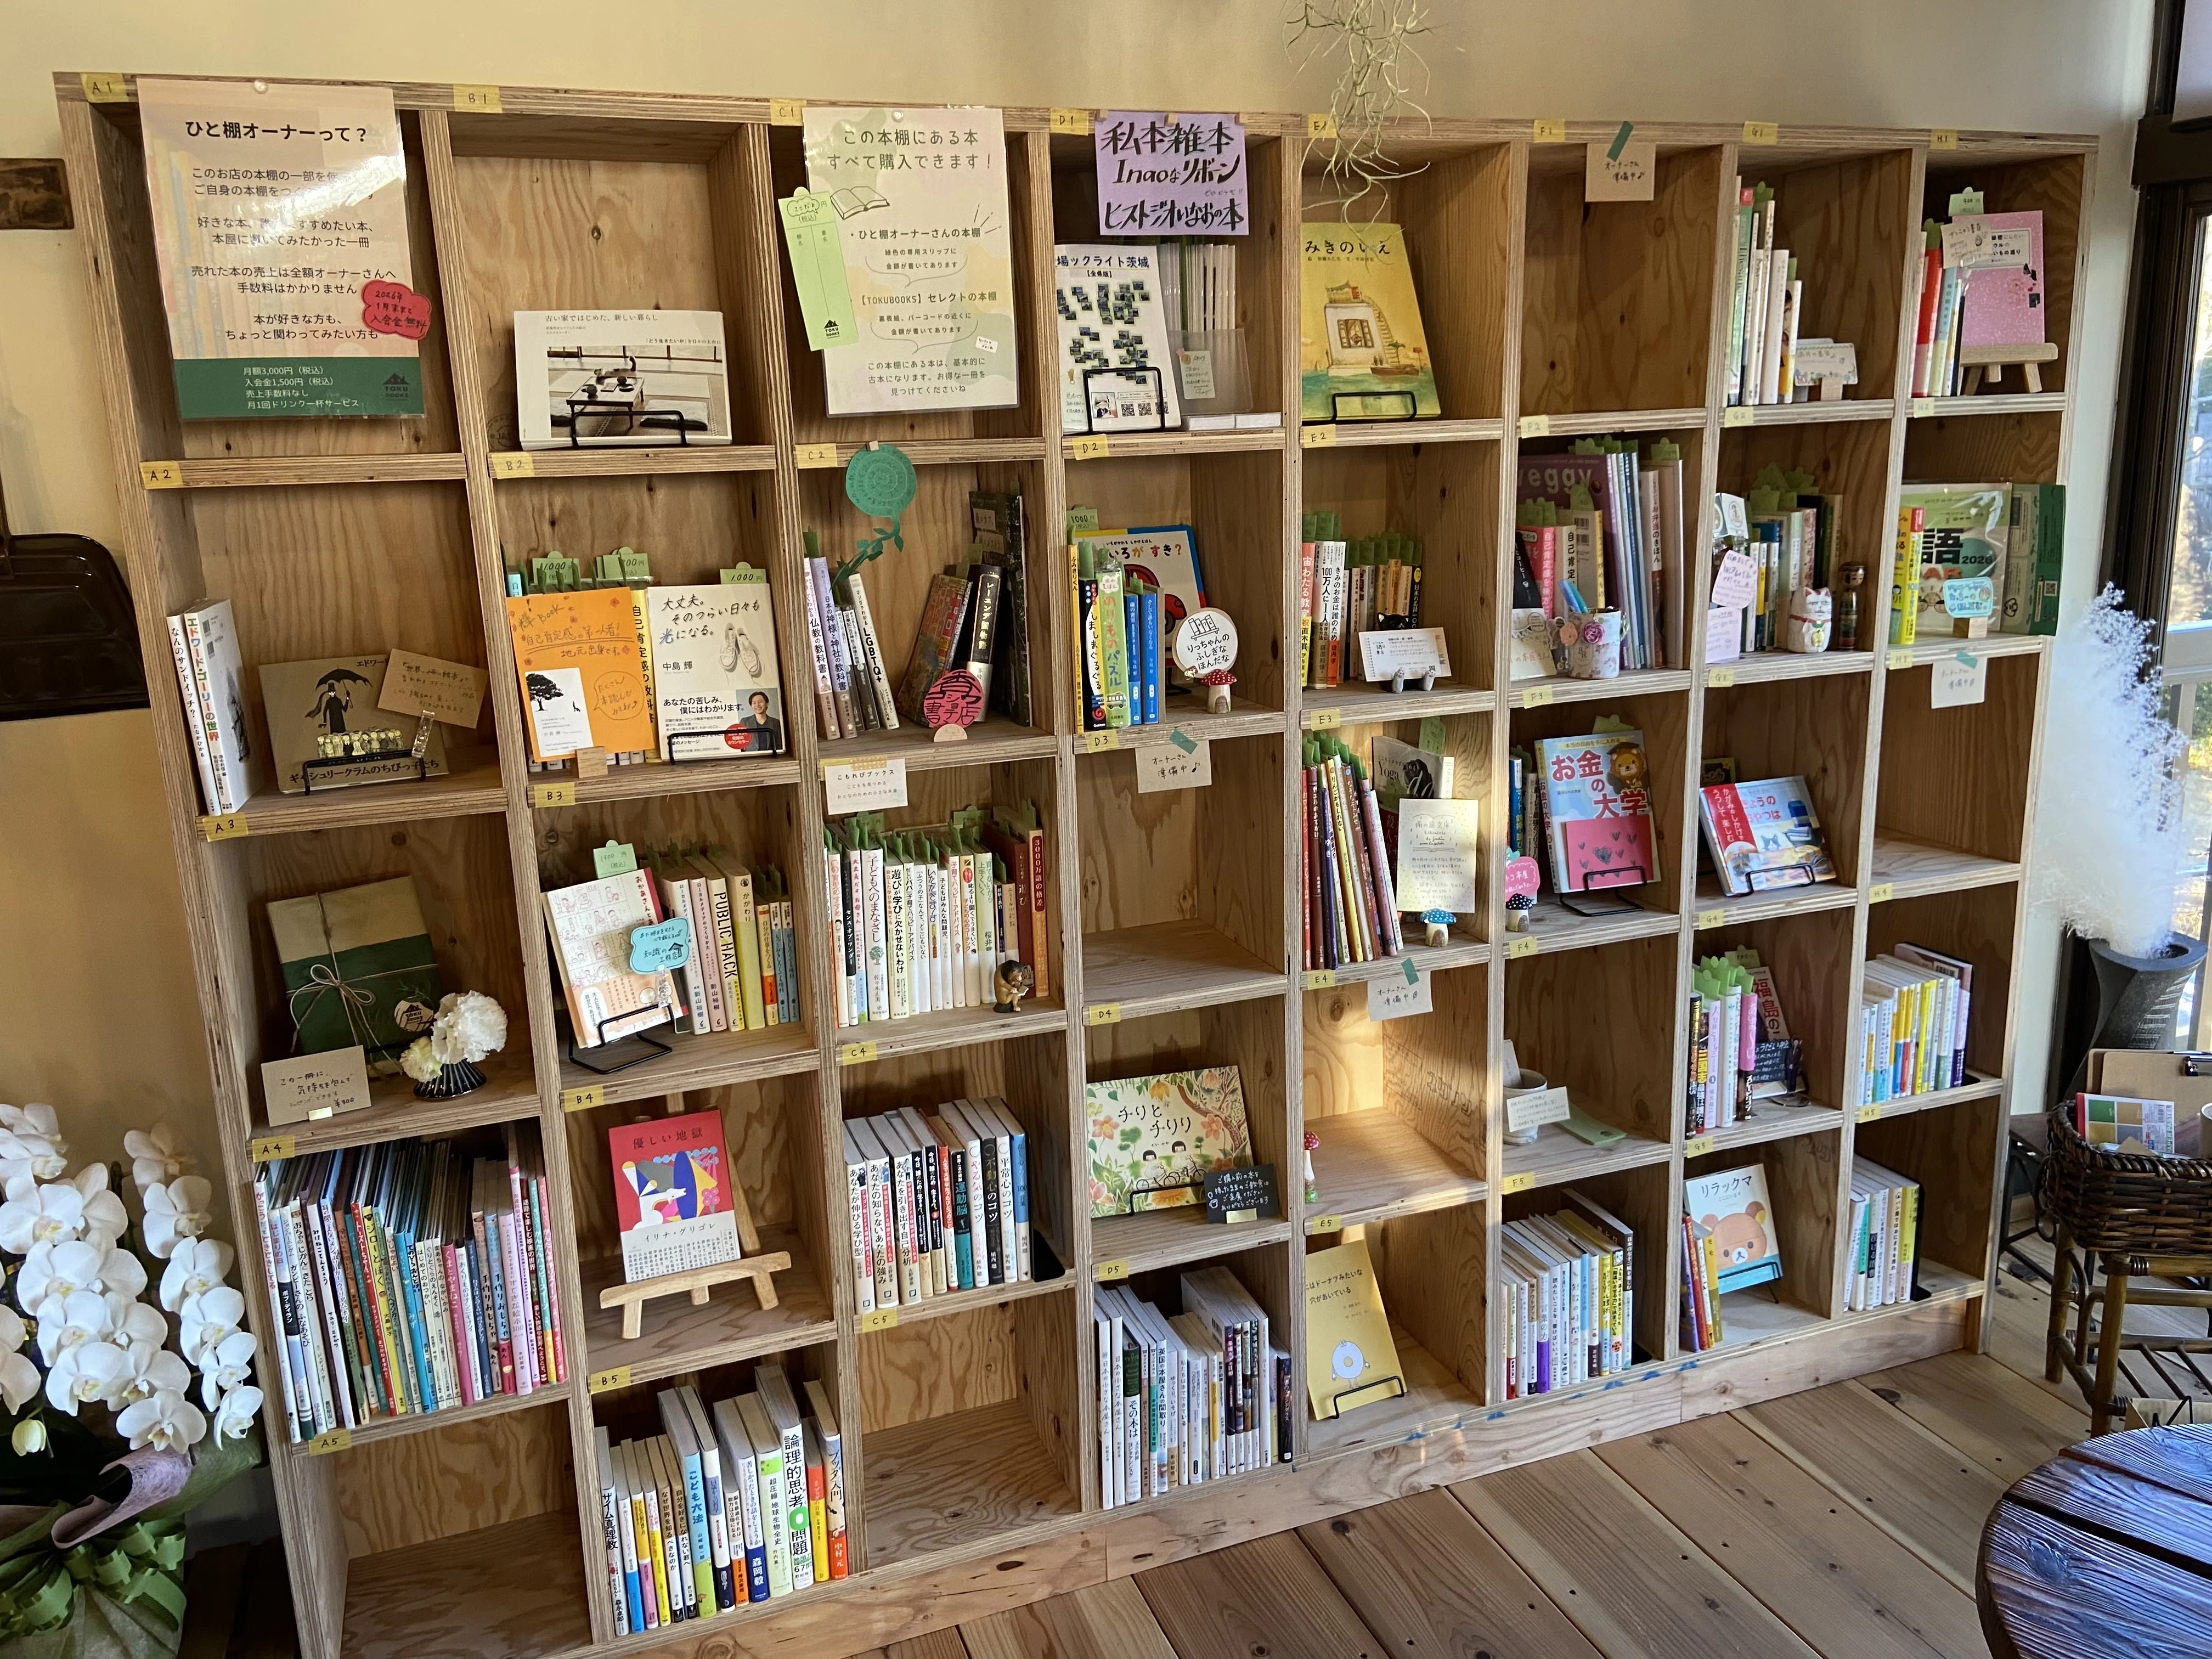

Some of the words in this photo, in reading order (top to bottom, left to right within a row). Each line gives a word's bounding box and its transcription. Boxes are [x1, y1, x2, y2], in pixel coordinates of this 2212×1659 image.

[92, 81, 114, 95] A1
[468, 92, 488, 104] B1
[778, 106, 795, 118] C1
[1059, 115, 1075, 126] D1
[185, 121, 368, 143] ひと棚オーナーって？
[844, 129, 979, 146] この本棚にある本
[1101, 120, 1235, 156] 私本雑本
[1540, 126, 1553, 136] F1
[1937, 134, 1948, 143] H1
[827, 153, 991, 170] すべて購入できます！
[1104, 198, 1244, 232] ヒストジオいなおの本
[885, 247, 957, 256] 緑色の専用スリップに
[191, 265, 396, 280] 売れた本の売上は全額オーナーさんへ
[886, 261, 958, 270] 金額が書いてあります
[237, 282, 357, 294] 手数料はかかりません
[253, 313, 343, 325] 本が好きな方も、
[370, 314, 427, 333] 入会金無料
[545, 314, 658, 322] 古い家ではじめた、新しい暮らし
[879, 312, 972, 322] 裏表紙、バーコードの近くに
[225, 329, 379, 340] ちょっと関わってみたい方も
[891, 326, 962, 335] 金額が書いてあります
[868, 358, 985, 370] この本棚にある本は、基本的に
[868, 371, 985, 384] 古本になります。お得な一冊を
[246, 389, 309, 398] 売上手数料なし
[891, 385, 966, 396] 見つけてくださいね
[247, 400, 359, 409] 月1回ドリンク一杯サービス
[1311, 432, 1327, 443] E2
[808, 450, 826, 460] C2
[1082, 442, 1099, 453] D2
[505, 459, 524, 471] B2
[150, 469, 172, 482] A2
[1651, 506, 1662, 563] お弁当のきほん
[1962, 555, 1993, 565] 2026
[1070, 556, 1079, 591] ふみきりくん
[662, 594, 704, 612] 大丈夫。
[1322, 567, 1333, 623] 100万人に1人
[672, 600, 760, 625] そのつらい日々も
[1330, 567, 1341, 641] きみのお金は誰のため
[659, 625, 714, 645] 光になる。
[825, 596, 847, 691] 日本の神様と神社の教科書
[1187, 634, 1230, 652] りっちゃんの
[810, 618, 827, 674] 仏教の教科書
[863, 627, 882, 682] LGBTQ+
[1088, 612, 1102, 690] しましまぐるぐる
[1196, 645, 1227, 662] ふしぎな
[1198, 654, 1230, 670] ほんだな
[187, 617, 220, 742] エドワード・ゴーリーの世界
[663, 697, 723, 707] あなたの苦しみ、
[1531, 691, 1543, 701] F3
[680, 704, 744, 715] 僕にはわかります。
[1318, 715, 1333, 724] E3
[1094, 736, 1109, 747] D3
[1152, 753, 1187, 765] オーナーさん
[1550, 749, 1605, 782] お金
[289, 759, 439, 784] ギシュリークラムのちびっ子たち
[837, 769, 895, 781] こもれびブックス
[1157, 764, 1188, 779] 準備中
[847, 780, 887, 789] こどもを見つめる
[546, 791, 563, 801] B3
[837, 789, 898, 800] おとなのための小さな本屋
[1331, 776, 1344, 832] りんごかもしれない
[1593, 788, 1647, 820] 大学
[215, 817, 235, 833] A3
[1035, 839, 1044, 907] 3000万語の格差
[867, 855, 882, 943] 子どもへのまなざし
[951, 861, 961, 936] 子育てハッピーアドバイス
[1874, 889, 1887, 898] H4
[697, 883, 711, 950] ローカルメディアのつくりかた
[714, 891, 732, 939] PUBLIC
[940, 878, 949, 939] 子どもはみんな問題児。
[967, 883, 977, 947] 叱るより聞くでうまくいく
[891, 868, 905, 974] 遊びが学びに欠かせないわけ
[1706, 915, 1718, 923] G4
[762, 920, 772, 969] 自分の仕事をつくる
[1517, 942, 1530, 951] F4
[721, 941, 738, 979] HACK
[1315, 974, 1328, 984] E4
[1376, 985, 1407, 997] オーナーさん
[1384, 995, 1409, 1007] 準備中
[1098, 1008, 1112, 1019] D4
[851, 1047, 867, 1057] C4
[576, 1093, 594, 1104] B4
[1118, 1104, 1163, 1123] チリと
[1150, 1117, 1191, 1138] チリリ
[633, 1126, 703, 1149] 優しい地獄
[262, 1143, 283, 1155] A4
[1000, 1158, 1012, 1219] 平常心のコツ
[1512, 1177, 1525, 1187] F5
[1701, 1174, 1753, 1198] リラックマ
[971, 1161, 984, 1223] やる気のコツ
[896, 1161, 911, 1266] あなたを引き出す自己分析
[645, 1222, 716, 1243] イリナ・グリゴレ
[870, 1164, 887, 1284] あなたの知らないあなたの強み
[255, 1192, 276, 1290] がっこうだってどきどきしてる
[365, 1224, 384, 1286] ジローとぼく
[417, 1250, 431, 1305] はじめてのおつかい
[1310, 1286, 1352, 1304] 穴があいている
[1114, 1356, 1122, 1430] 日本の小さな本屋さん
[1158, 1347, 1167, 1427] 英国の本屋さんの間取り
[1128, 1400, 1139, 1438] その本は
[320, 1437, 340, 1447] A5
[784, 1434, 803, 1508] 論理的思考
[689, 1469, 704, 1525] こども六法
[746, 1460, 761, 1545] 苦しかったときの話をしようか
[602, 1492, 619, 1551] ザイム真理教
[676, 1489, 691, 1566] 自分を好きになれない君へ
[834, 1543, 844, 1567] 中村元
